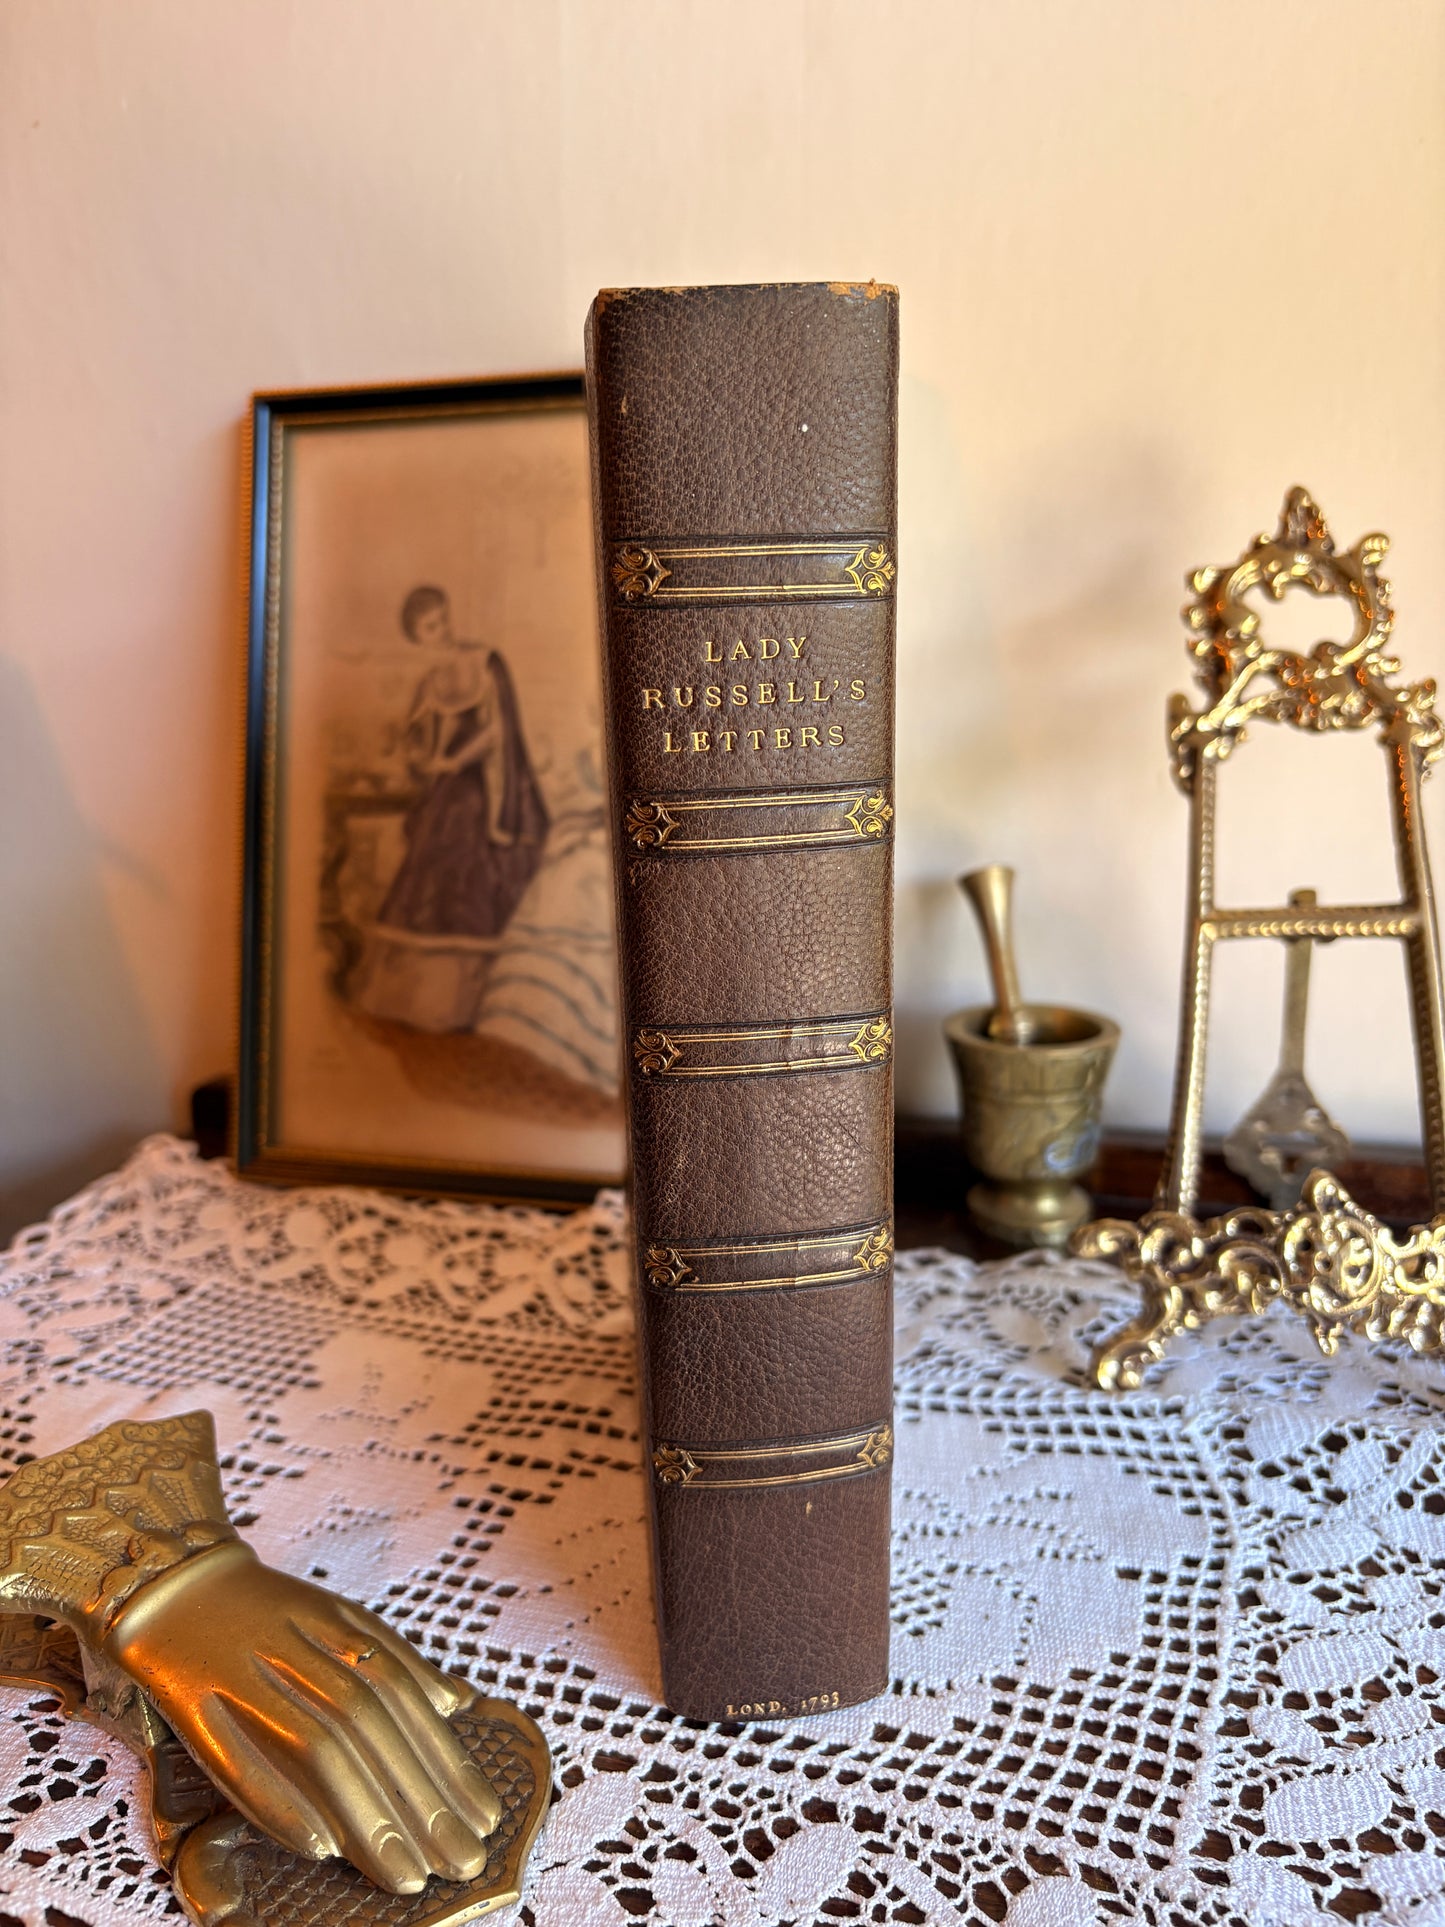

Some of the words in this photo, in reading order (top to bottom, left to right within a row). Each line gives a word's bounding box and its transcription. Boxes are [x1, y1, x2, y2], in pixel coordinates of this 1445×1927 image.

[705, 637, 807, 663] LADY
[642, 680, 866, 709] RUSSELL'S
[664, 726, 844, 752] LETTERS
[726, 1700, 786, 1716] LOND.
